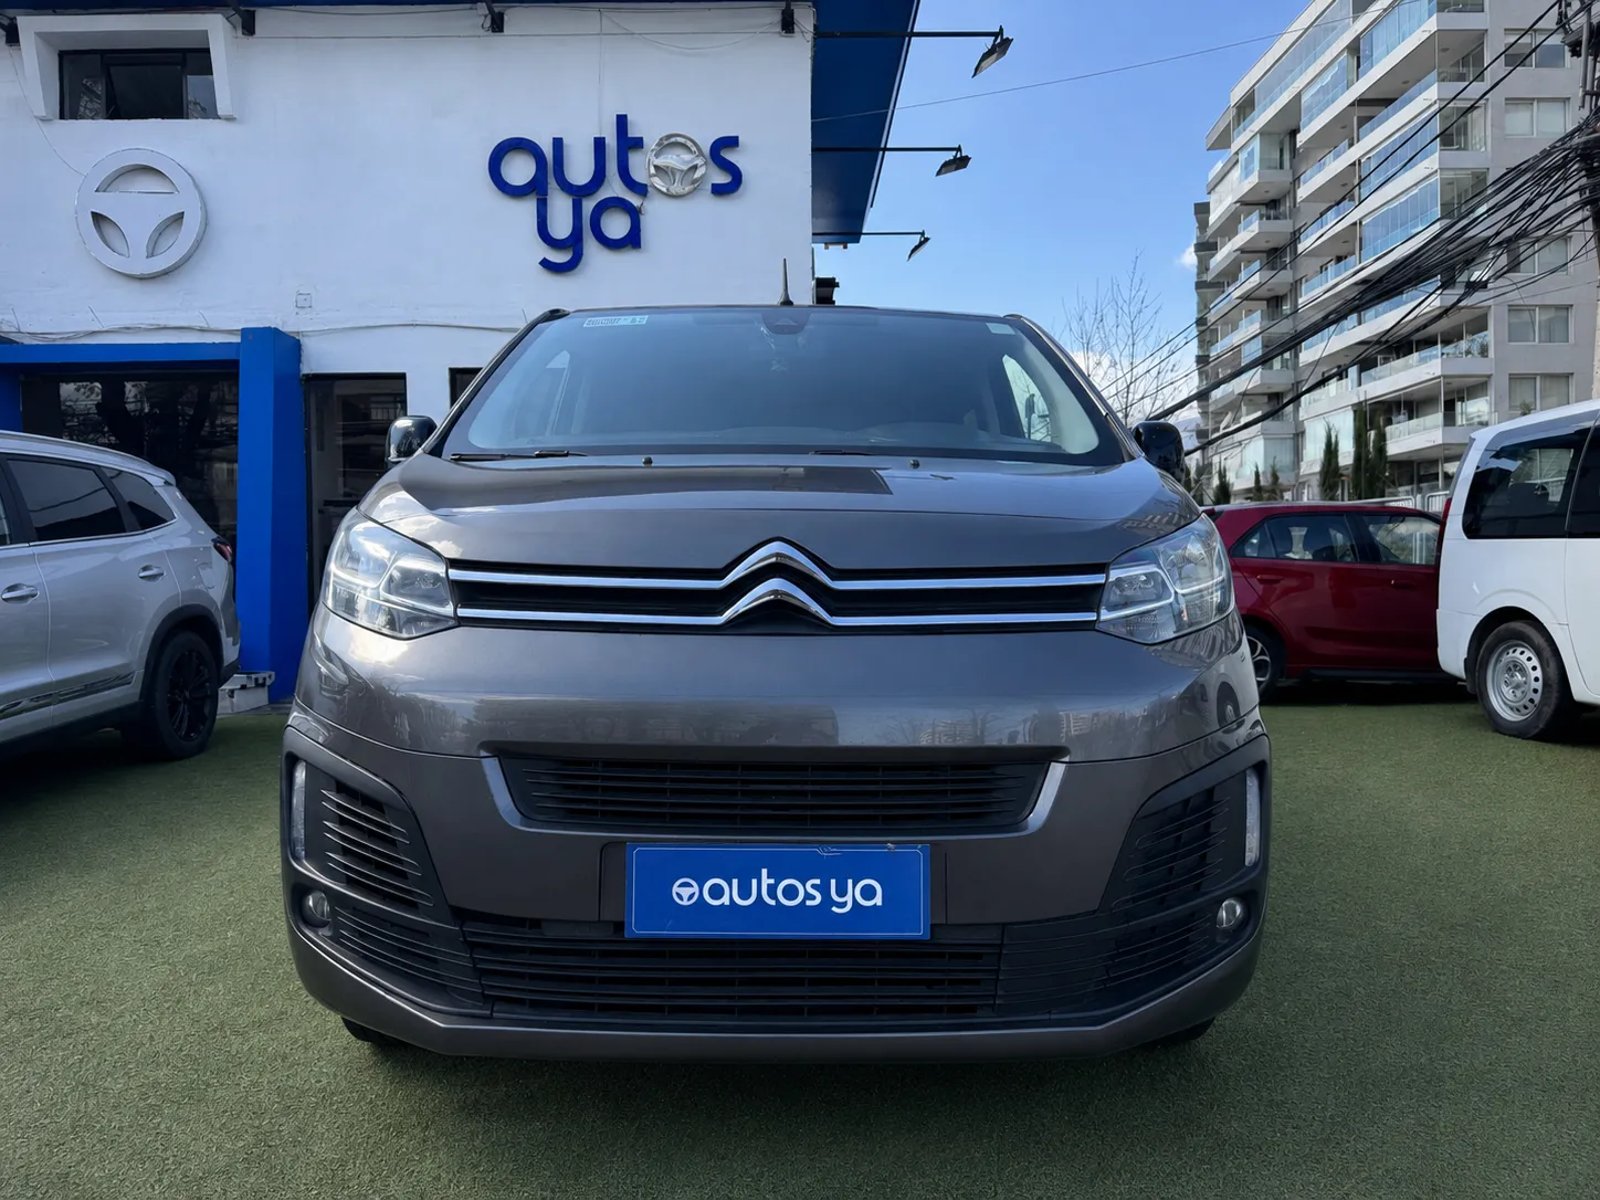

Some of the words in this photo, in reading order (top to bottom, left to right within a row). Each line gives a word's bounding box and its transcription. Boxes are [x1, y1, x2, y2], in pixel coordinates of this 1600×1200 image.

[536, 196, 642, 273] ya
[702, 868, 822, 906] autos
[830, 878, 882, 914] ya
